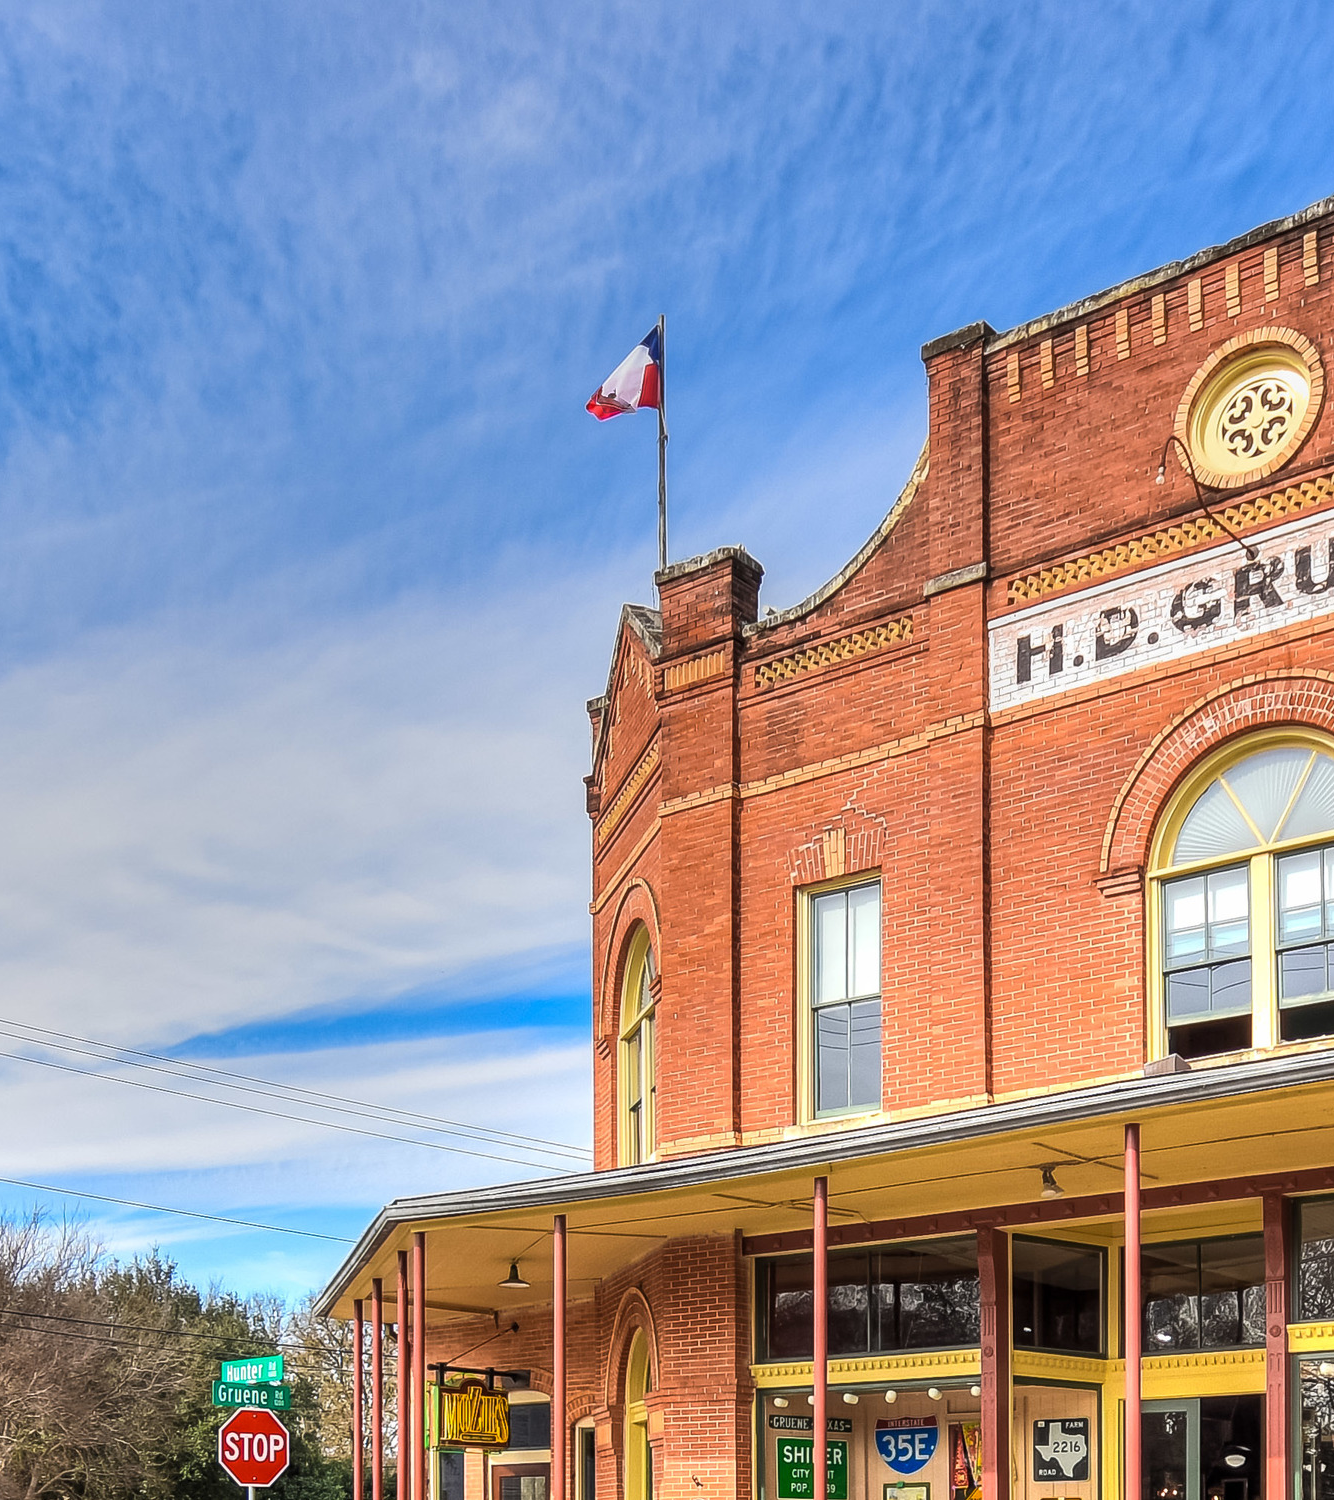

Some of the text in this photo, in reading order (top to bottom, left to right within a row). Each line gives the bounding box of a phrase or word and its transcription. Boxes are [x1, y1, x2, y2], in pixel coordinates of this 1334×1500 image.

[227, 1362, 264, 1382] Hunter
[218, 1384, 268, 1405] Gruene
[274, 1390, 284, 1400] Rd
[773, 1416, 810, 1430] GRUENE
[887, 1418, 925, 1428] INTERSTATE
[1065, 1421, 1084, 1429] FARM
[224, 1432, 285, 1463] STOP
[881, 1433, 930, 1462] 35E
[1052, 1441, 1081, 1453] 2216
[783, 1445, 843, 1465] SHIER
[791, 1468, 810, 1479] CITY
[1038, 1468, 1057, 1476] ROAD
